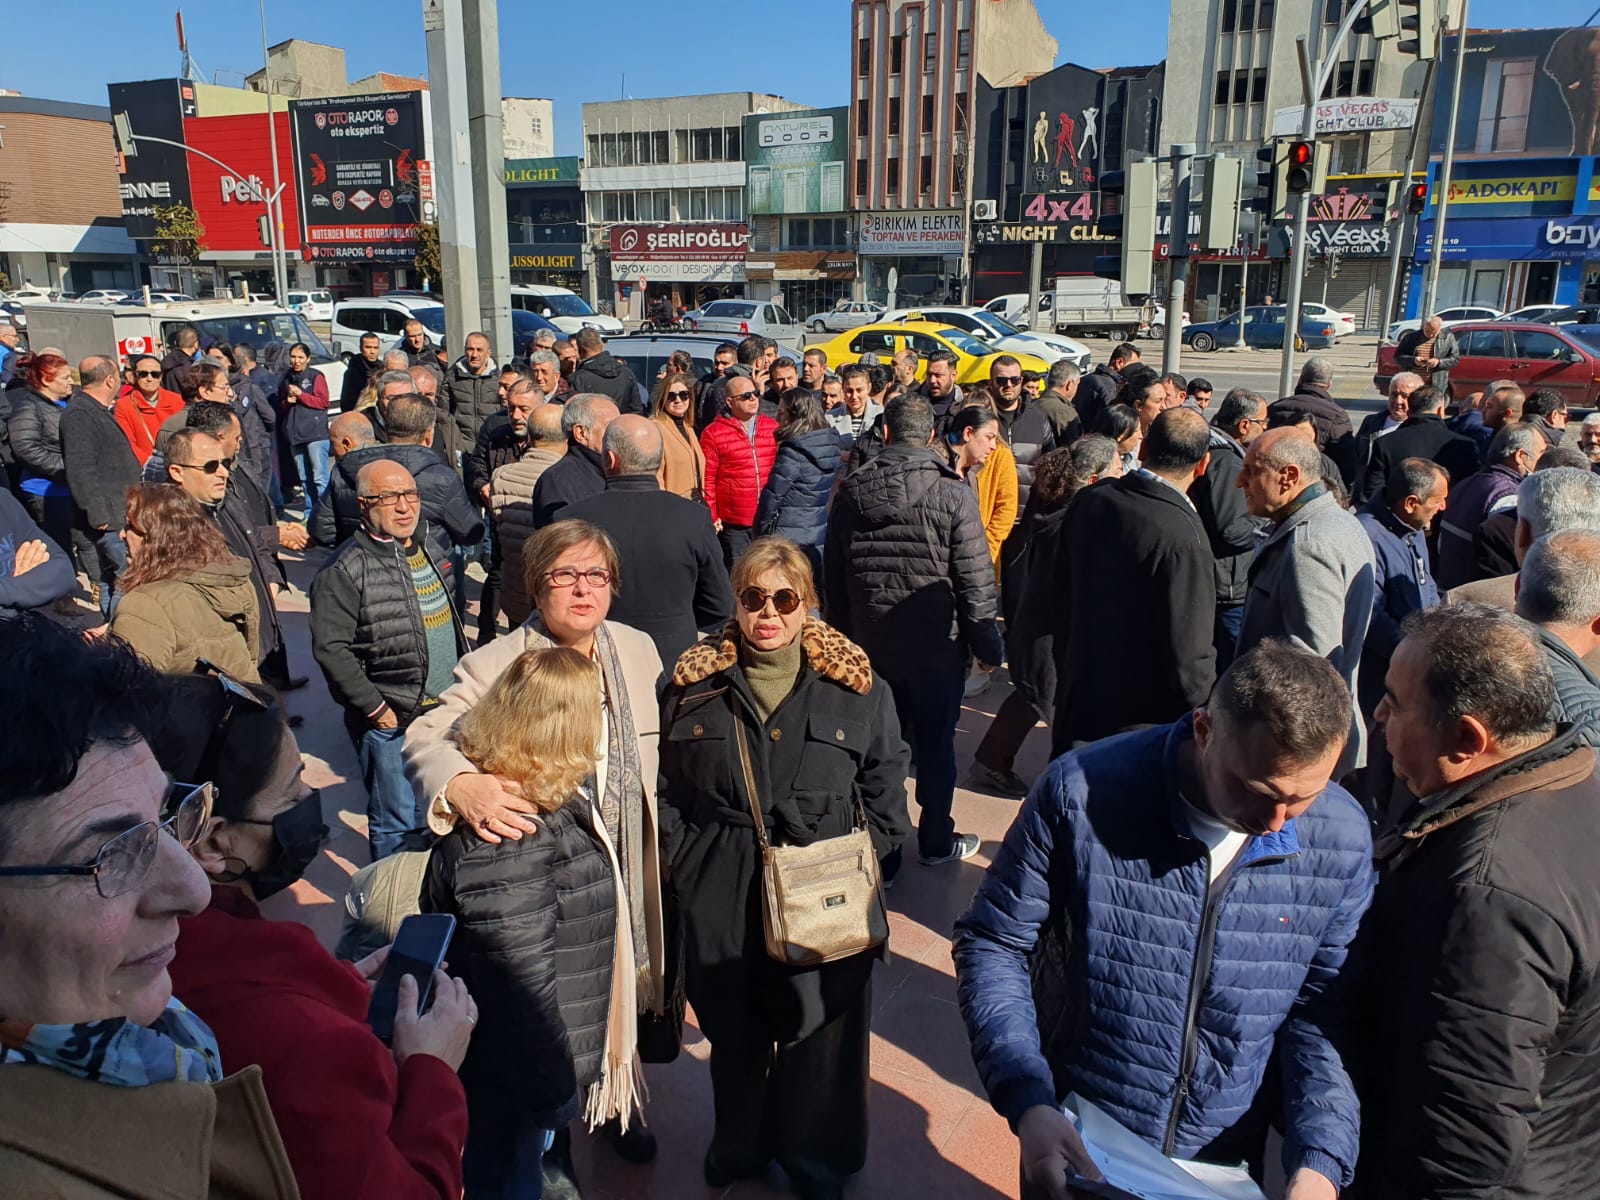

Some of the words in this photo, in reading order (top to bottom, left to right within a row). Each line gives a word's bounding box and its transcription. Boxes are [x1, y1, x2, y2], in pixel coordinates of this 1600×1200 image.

[1316, 106, 1333, 117] AS
[1340, 101, 1390, 115] VEGAS
[328, 109, 384, 125] OTORAPOR
[1316, 118, 1344, 129] GHT
[1350, 115, 1384, 127] CLUB
[331, 127, 344, 137] oto
[345, 124, 384, 138] ekspertiz
[1466, 181, 1558, 198] ADOKAPI
[922, 215, 964, 230] ELEKTRI
[312, 229, 344, 240] NOTERDEN
[345, 227, 362, 239] ÖNCE
[364, 228, 417, 239] #OTORAPORLAYI
[647, 229, 744, 250] ŞERİFOĞLU
[871, 231, 904, 242] TOPTAN
[907, 231, 918, 241] VE
[920, 231, 965, 241] PERAKEN
[1002, 225, 1058, 241] NIGHT
[1070, 225, 1117, 241] CLU
[320, 247, 365, 257] OTORAPOR
